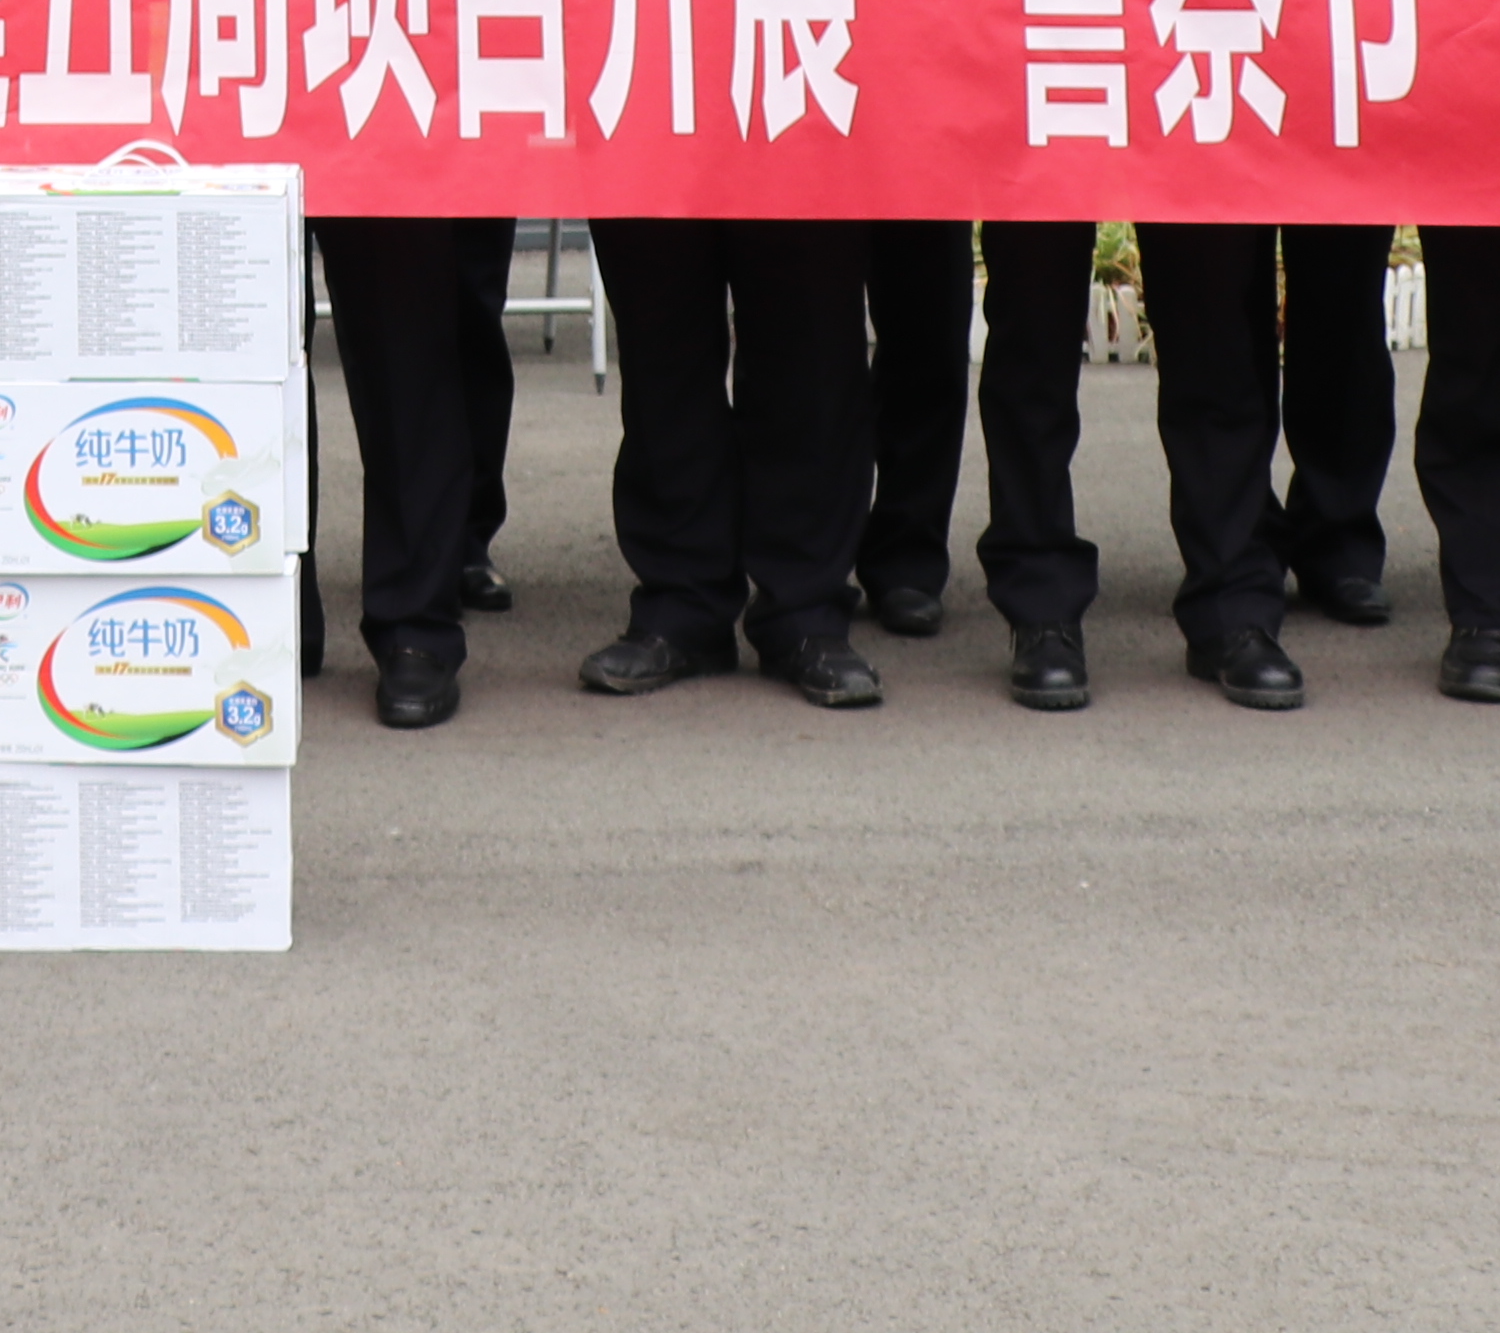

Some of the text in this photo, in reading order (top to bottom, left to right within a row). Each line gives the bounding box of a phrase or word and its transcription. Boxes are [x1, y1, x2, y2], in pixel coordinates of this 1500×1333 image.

[75, 428, 187, 468] 纯牛奶
[214, 515, 249, 535] 3.2g
[87, 617, 200, 659] 纯牛奶
[227, 706, 262, 726] 3.2g
